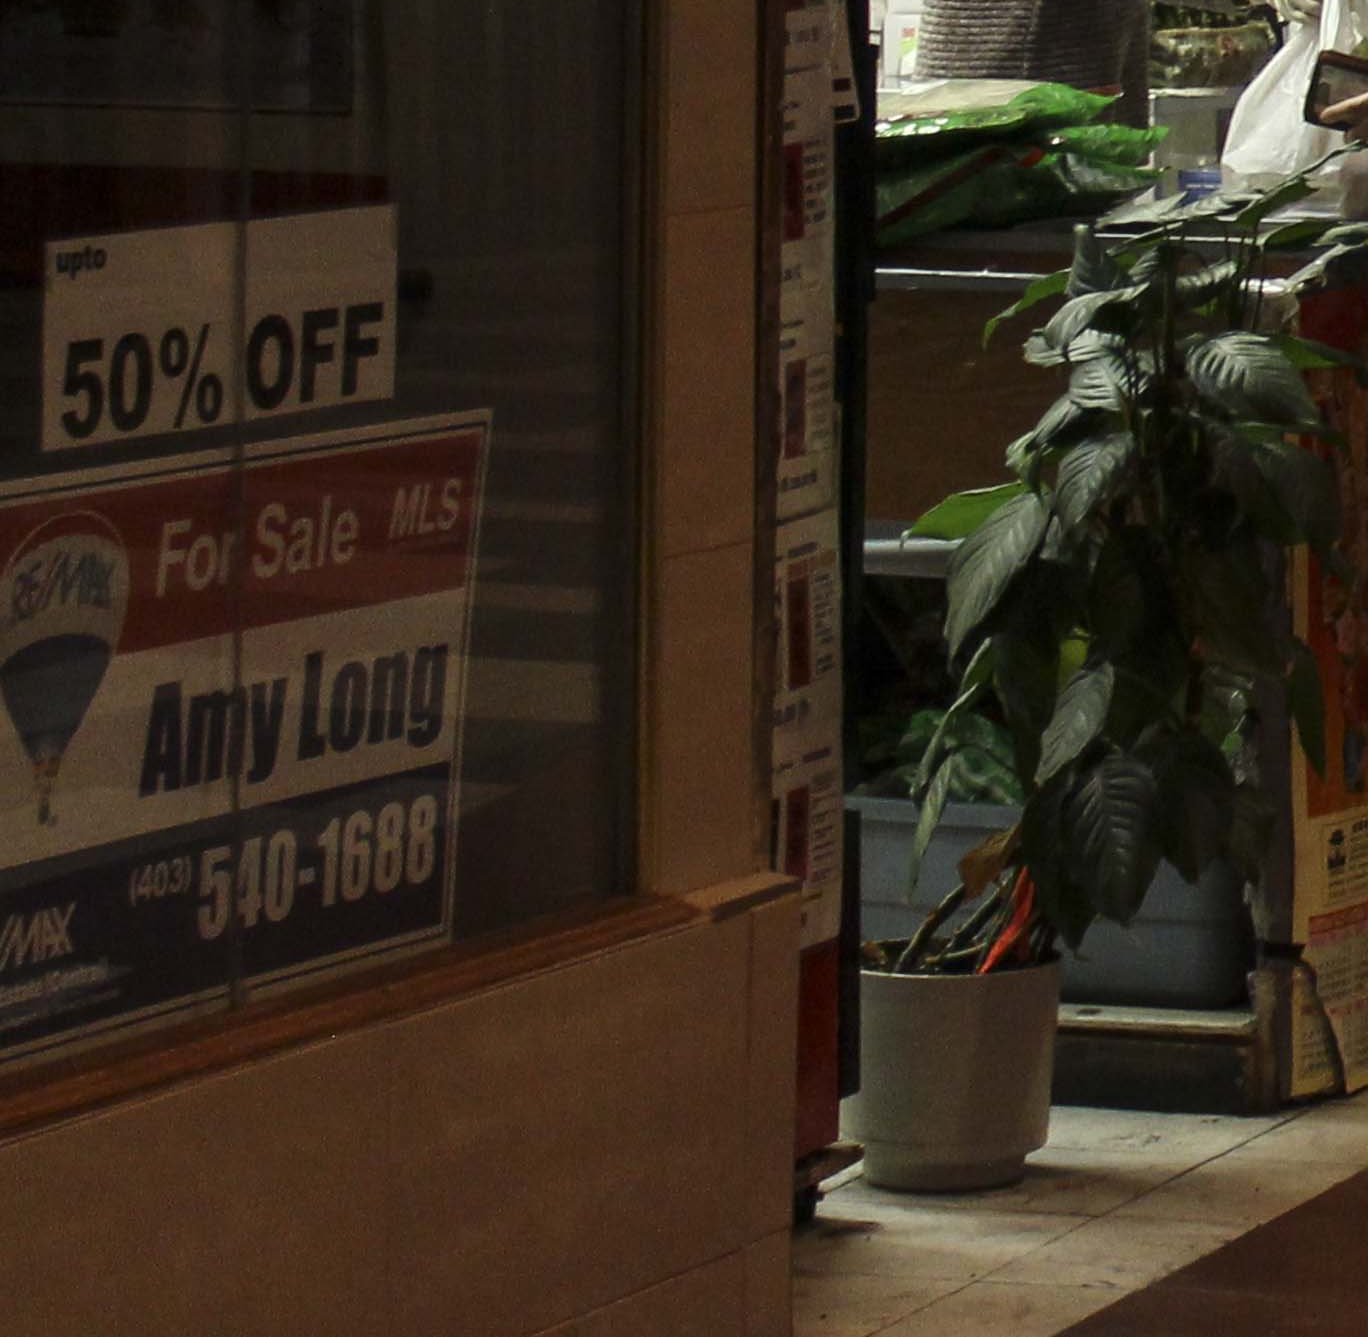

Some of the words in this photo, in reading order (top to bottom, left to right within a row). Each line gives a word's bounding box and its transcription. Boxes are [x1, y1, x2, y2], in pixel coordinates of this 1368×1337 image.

[56, 244, 107, 275] upto
[60, 322, 223, 440] 50%
[246, 301, 384, 410] OFF
[155, 518, 236, 598] For
[252, 492, 359, 581] Sale
[388, 476, 463, 540] MLS
[139, 680, 287, 798] Amy
[296, 641, 449, 762] Long
[128, 855, 193, 907] (403)
[198, 794, 438, 941] 540-1688
